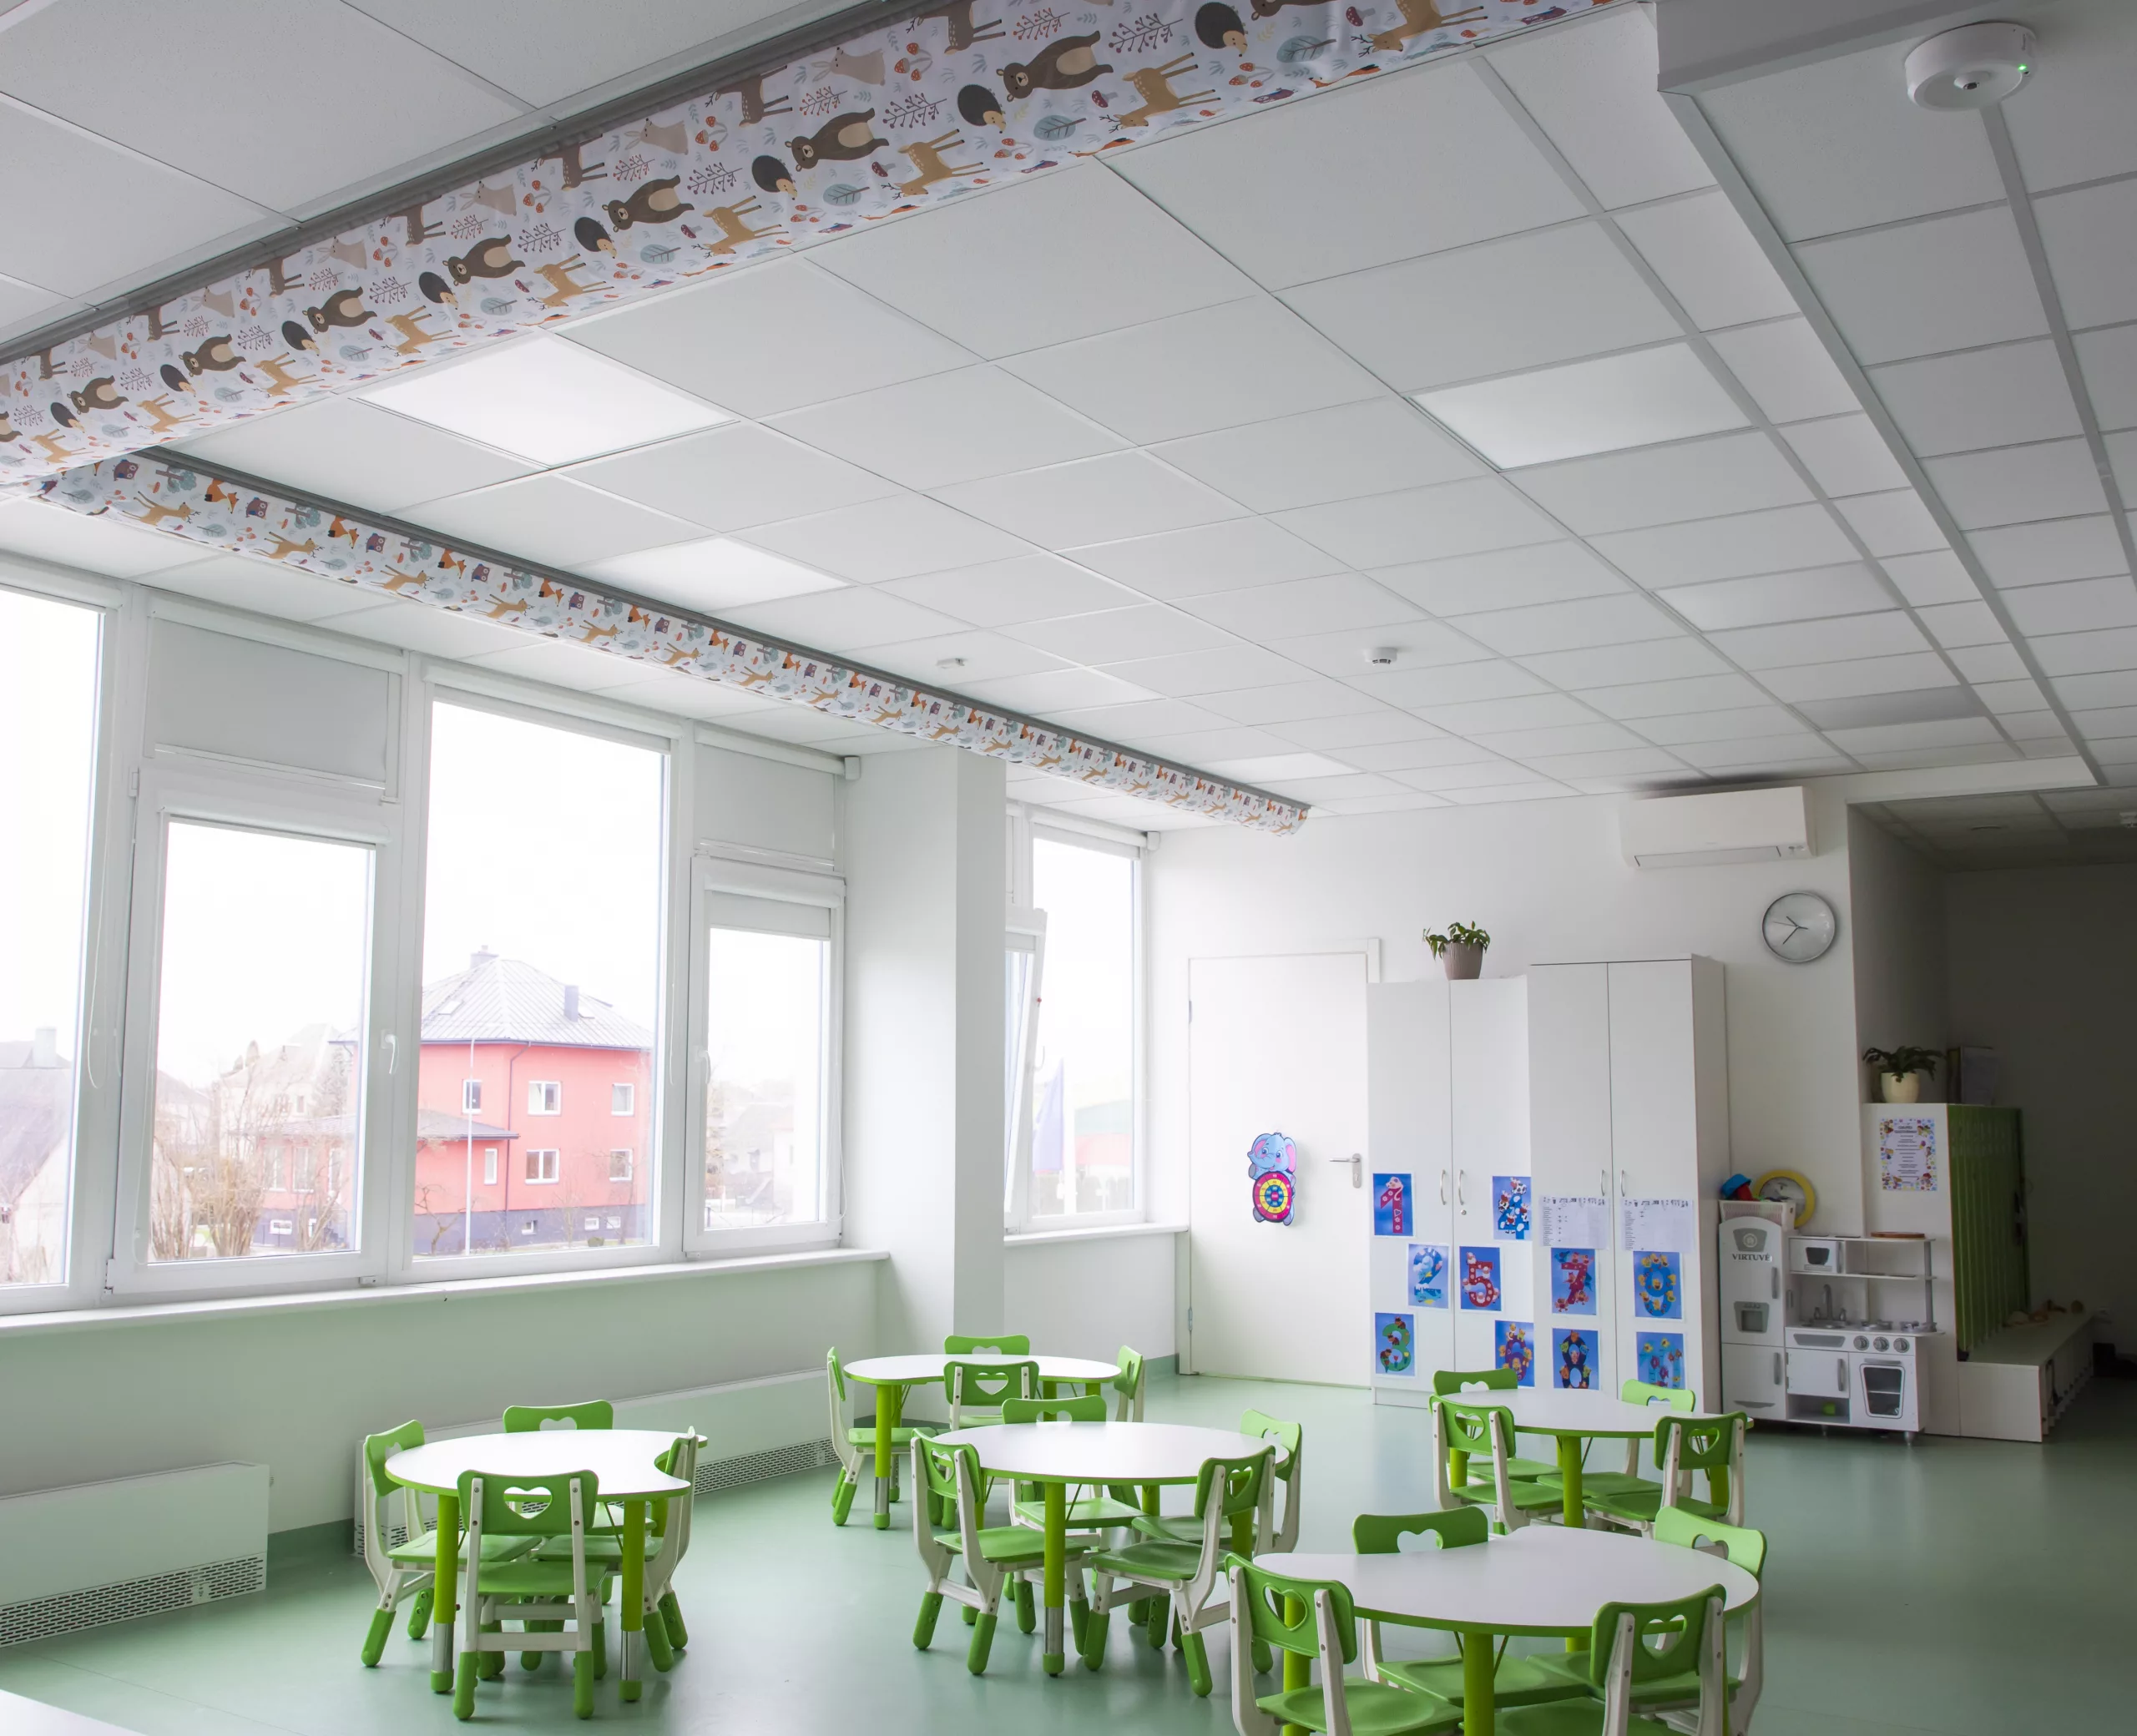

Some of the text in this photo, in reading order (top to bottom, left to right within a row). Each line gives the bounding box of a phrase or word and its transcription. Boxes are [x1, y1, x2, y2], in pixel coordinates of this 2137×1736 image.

[1381, 1185, 1403, 1234] 1
[1498, 1193, 1529, 1239] 4
[1413, 1248, 1442, 1299] 2
[1468, 1261, 1496, 1308] 5
[1561, 1261, 1589, 1305] 7
[1644, 1262, 1674, 1316] 9
[1381, 1324, 1412, 1371] 3
[1505, 1335, 1527, 1381] 6
[1562, 1332, 1589, 1389] 8
